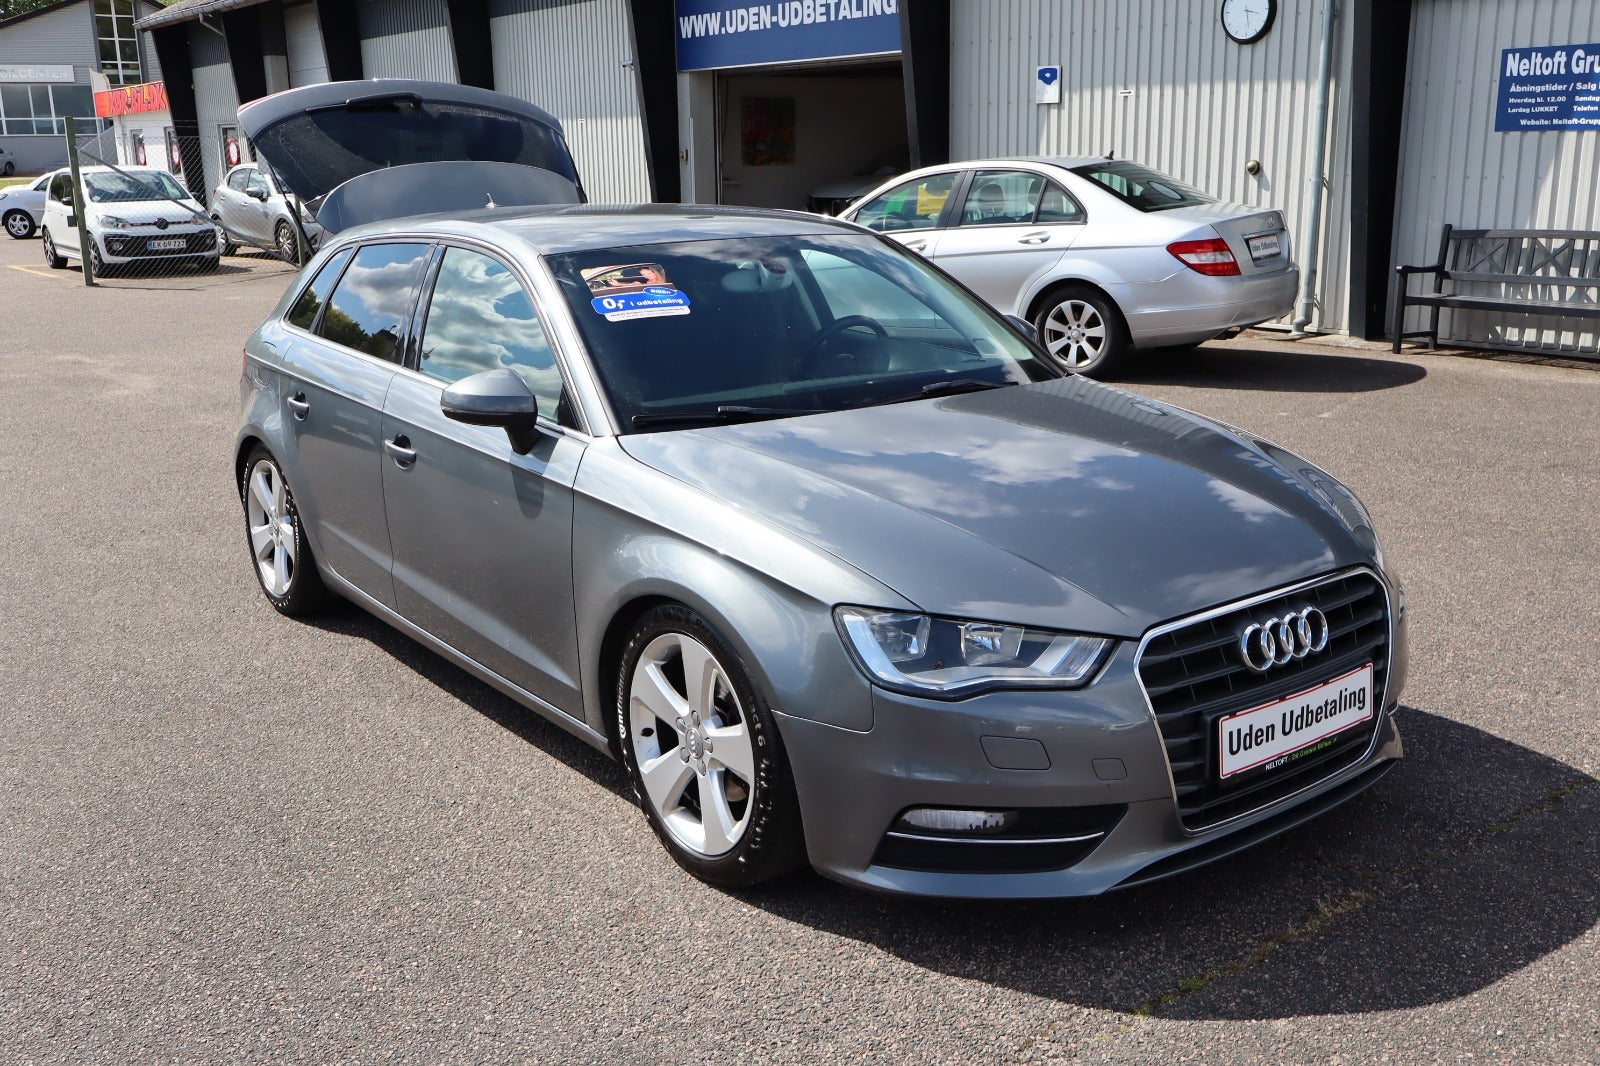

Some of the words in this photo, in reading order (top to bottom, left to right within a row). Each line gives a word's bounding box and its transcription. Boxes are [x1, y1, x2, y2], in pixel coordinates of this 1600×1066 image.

[1505, 50, 1568, 77] Neltoft
[1509, 82, 1568, 93] Åbningstider
[1575, 82, 1597, 91] Salg
[1519, 118, 1551, 126] Website:
[637, 297, 684, 306] udbetaling
[1228, 722, 1276, 756] Uden
[1281, 686, 1367, 737] Udbetaling
[1265, 756, 1289, 771] NELTOFT
